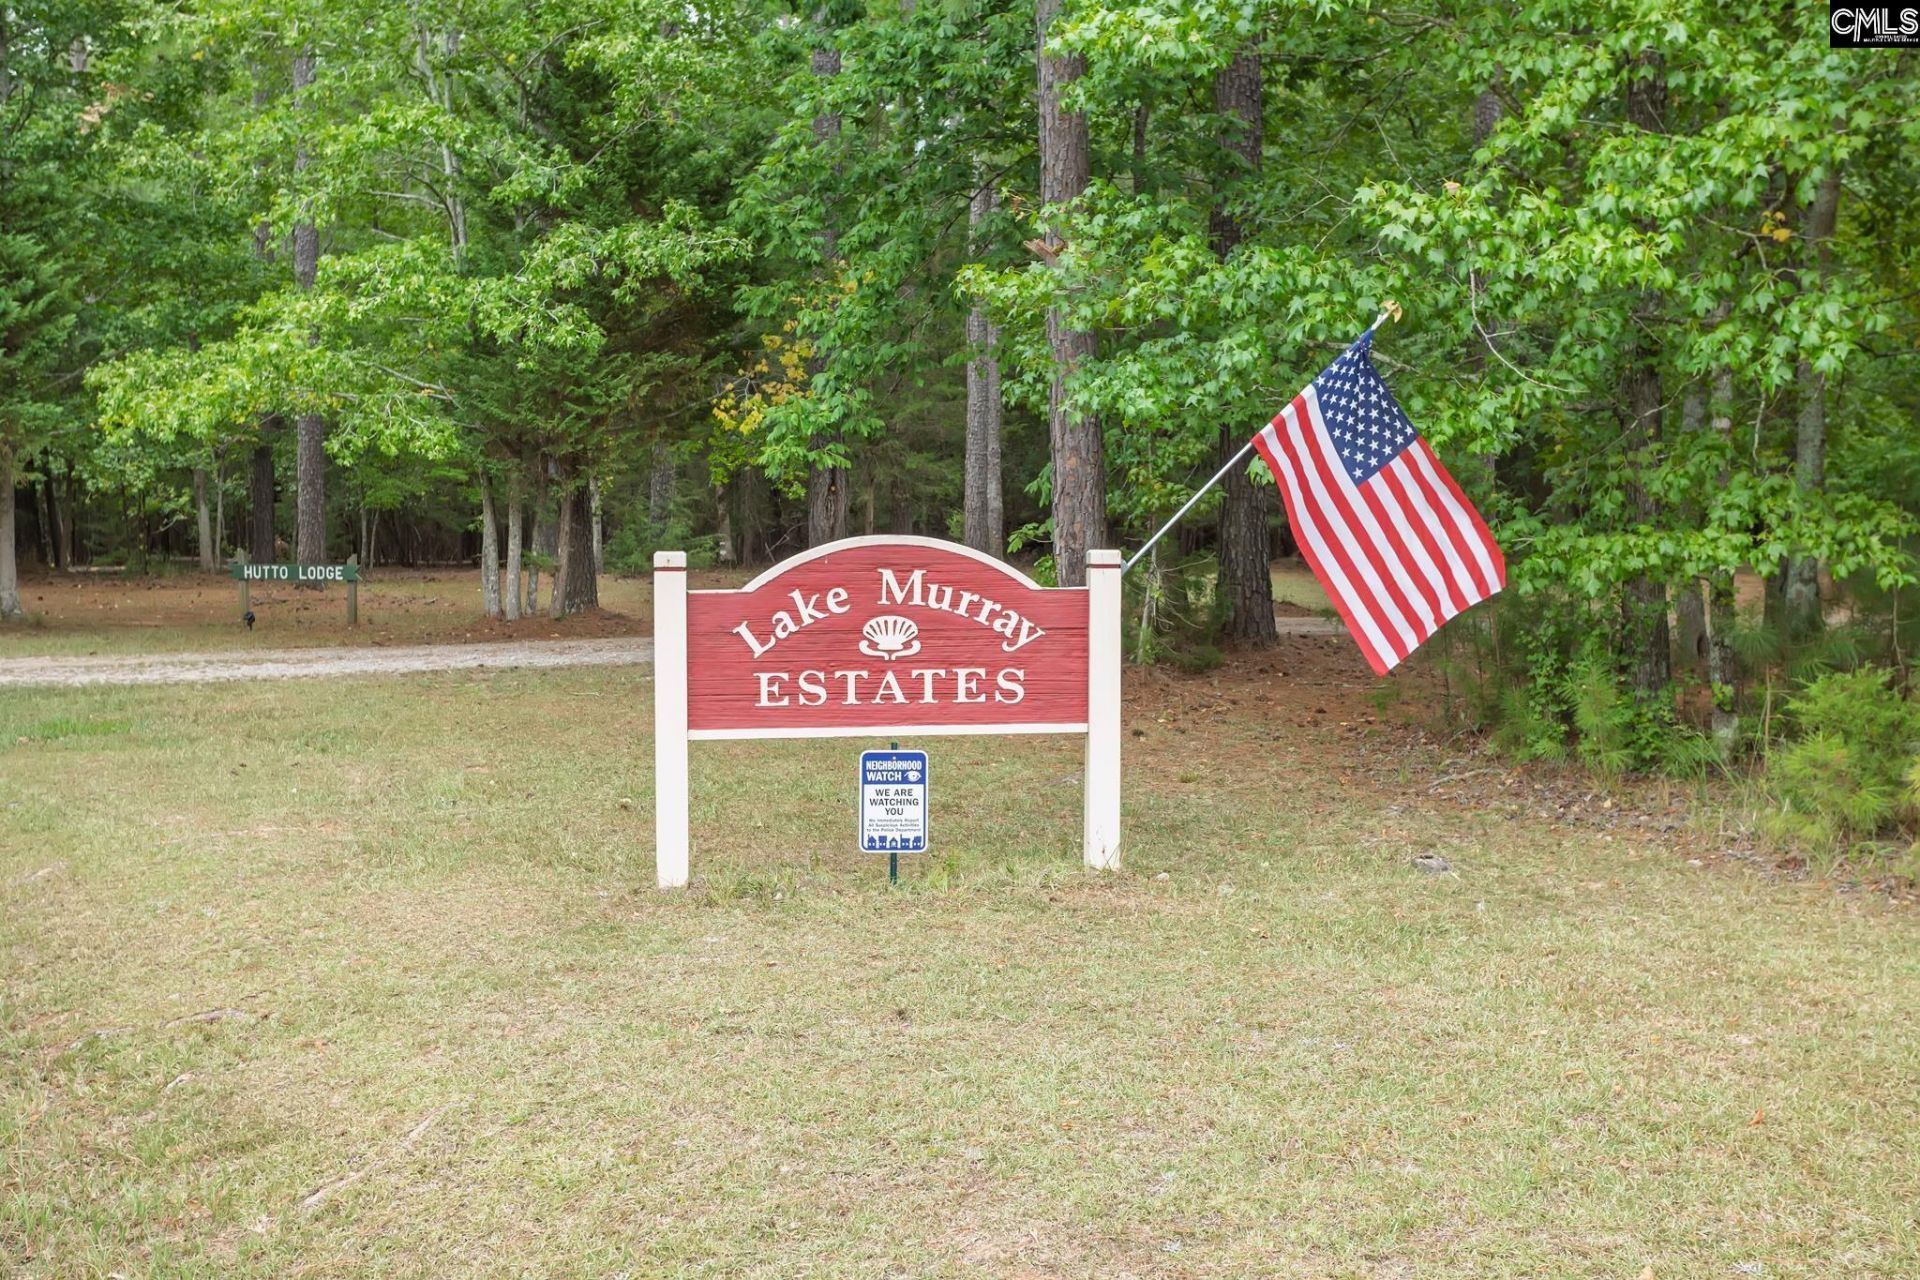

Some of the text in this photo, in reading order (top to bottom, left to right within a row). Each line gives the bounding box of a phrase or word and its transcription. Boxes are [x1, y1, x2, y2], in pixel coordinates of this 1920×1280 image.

[244, 565, 344, 580] HUTTO LODGE
[732, 567, 1046, 659] Lake Murray
[752, 667, 1026, 707] ESTATES
[866, 760, 922, 770] NEIGHBORHOOD
[866, 771, 902, 782] WATCH
[875, 788, 913, 797] WE ARE
[869, 798, 919, 806] WATCHING
[885, 807, 904, 816] YOU
